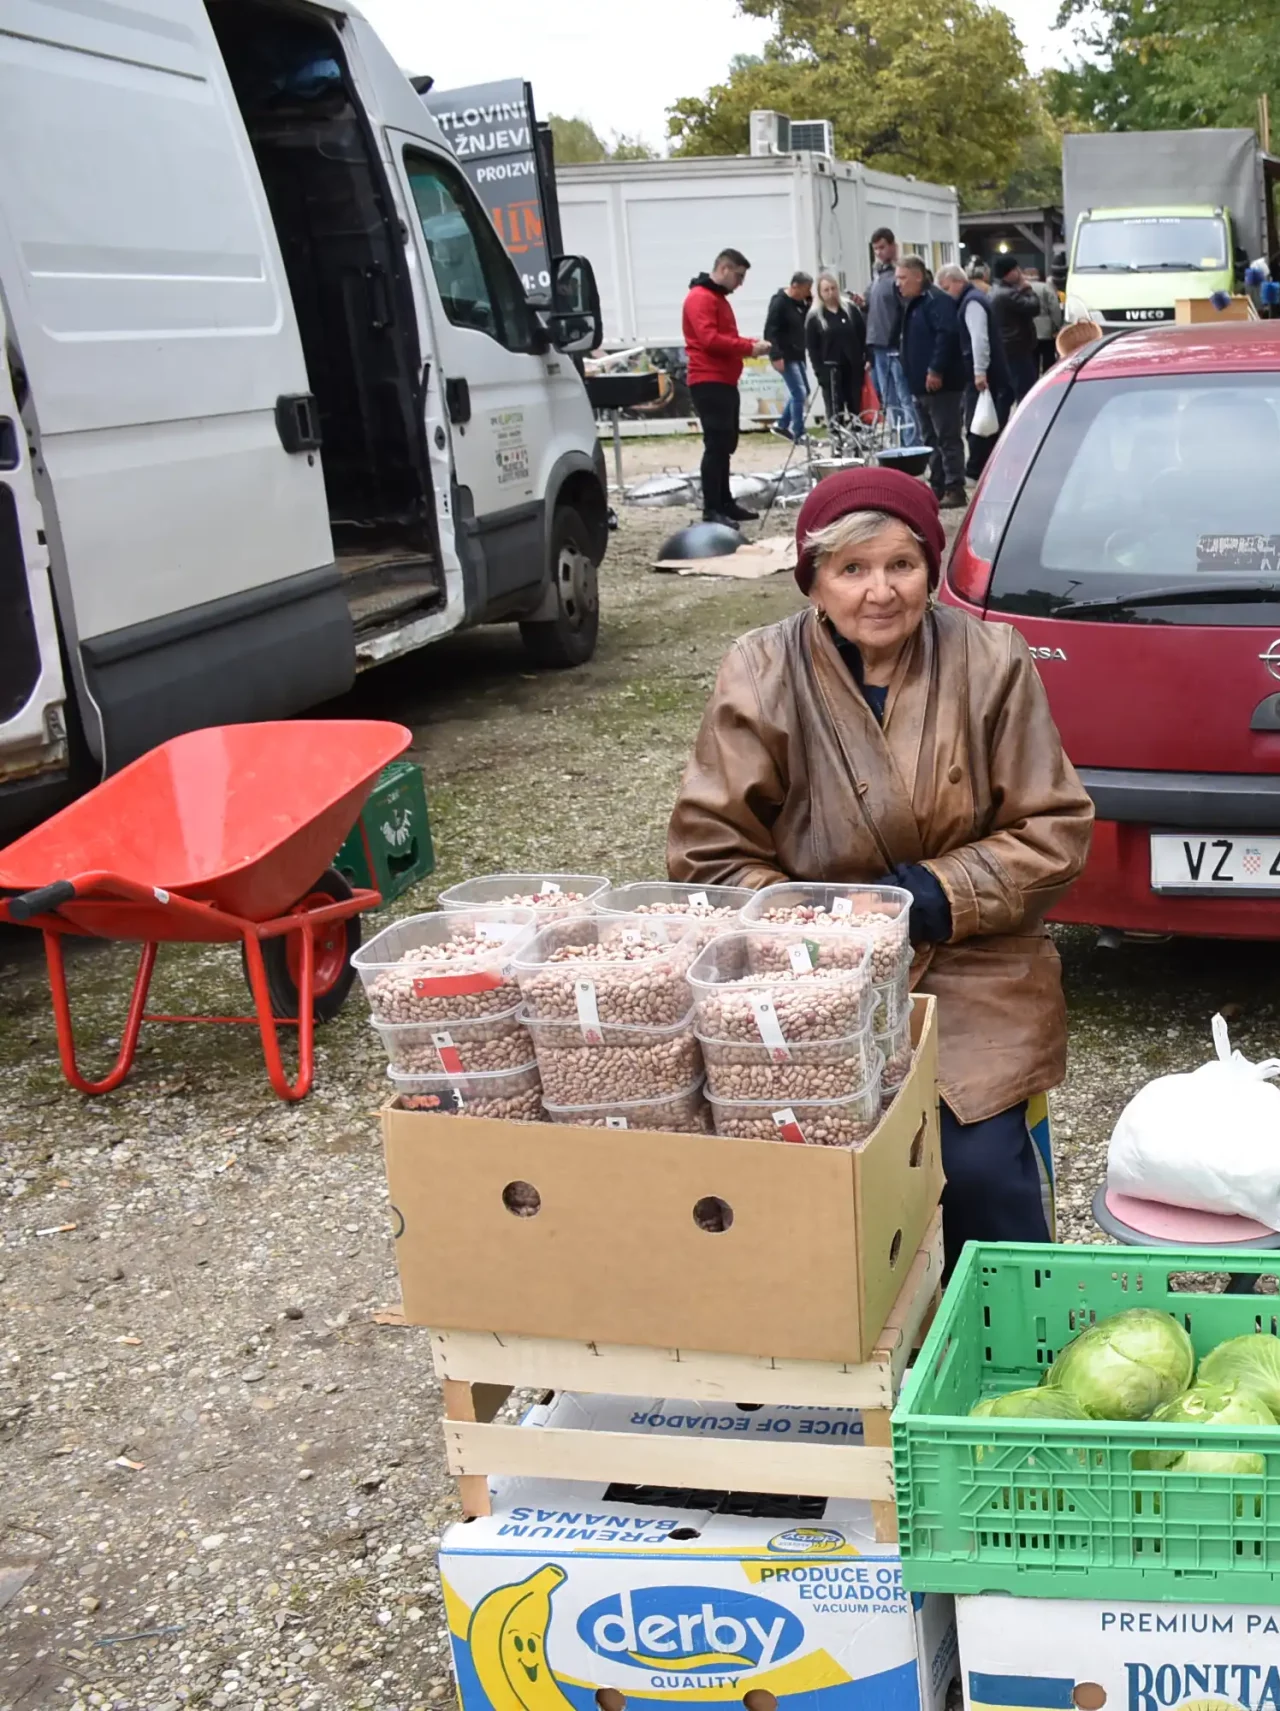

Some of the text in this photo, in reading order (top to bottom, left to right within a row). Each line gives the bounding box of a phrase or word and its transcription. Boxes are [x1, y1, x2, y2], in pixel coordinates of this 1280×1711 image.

[447, 128, 531, 155] ŽNJEVI
[1125, 310, 1165, 320] IVECO
[630, 1411, 749, 1432] ECUADOR
[756, 1418, 792, 1433] OF
[509, 1506, 680, 1531] BANANAS
[496, 1523, 670, 1543] PREMIUM
[760, 1567, 903, 1584] PRODUCE OF
[799, 1583, 908, 1601] ECUADOR
[812, 1603, 908, 1614] VACUUM PACK
[593, 1589, 787, 1671] derby
[1101, 1611, 1234, 1633] PREMIUM
[650, 1675, 741, 1689] QUALITY
